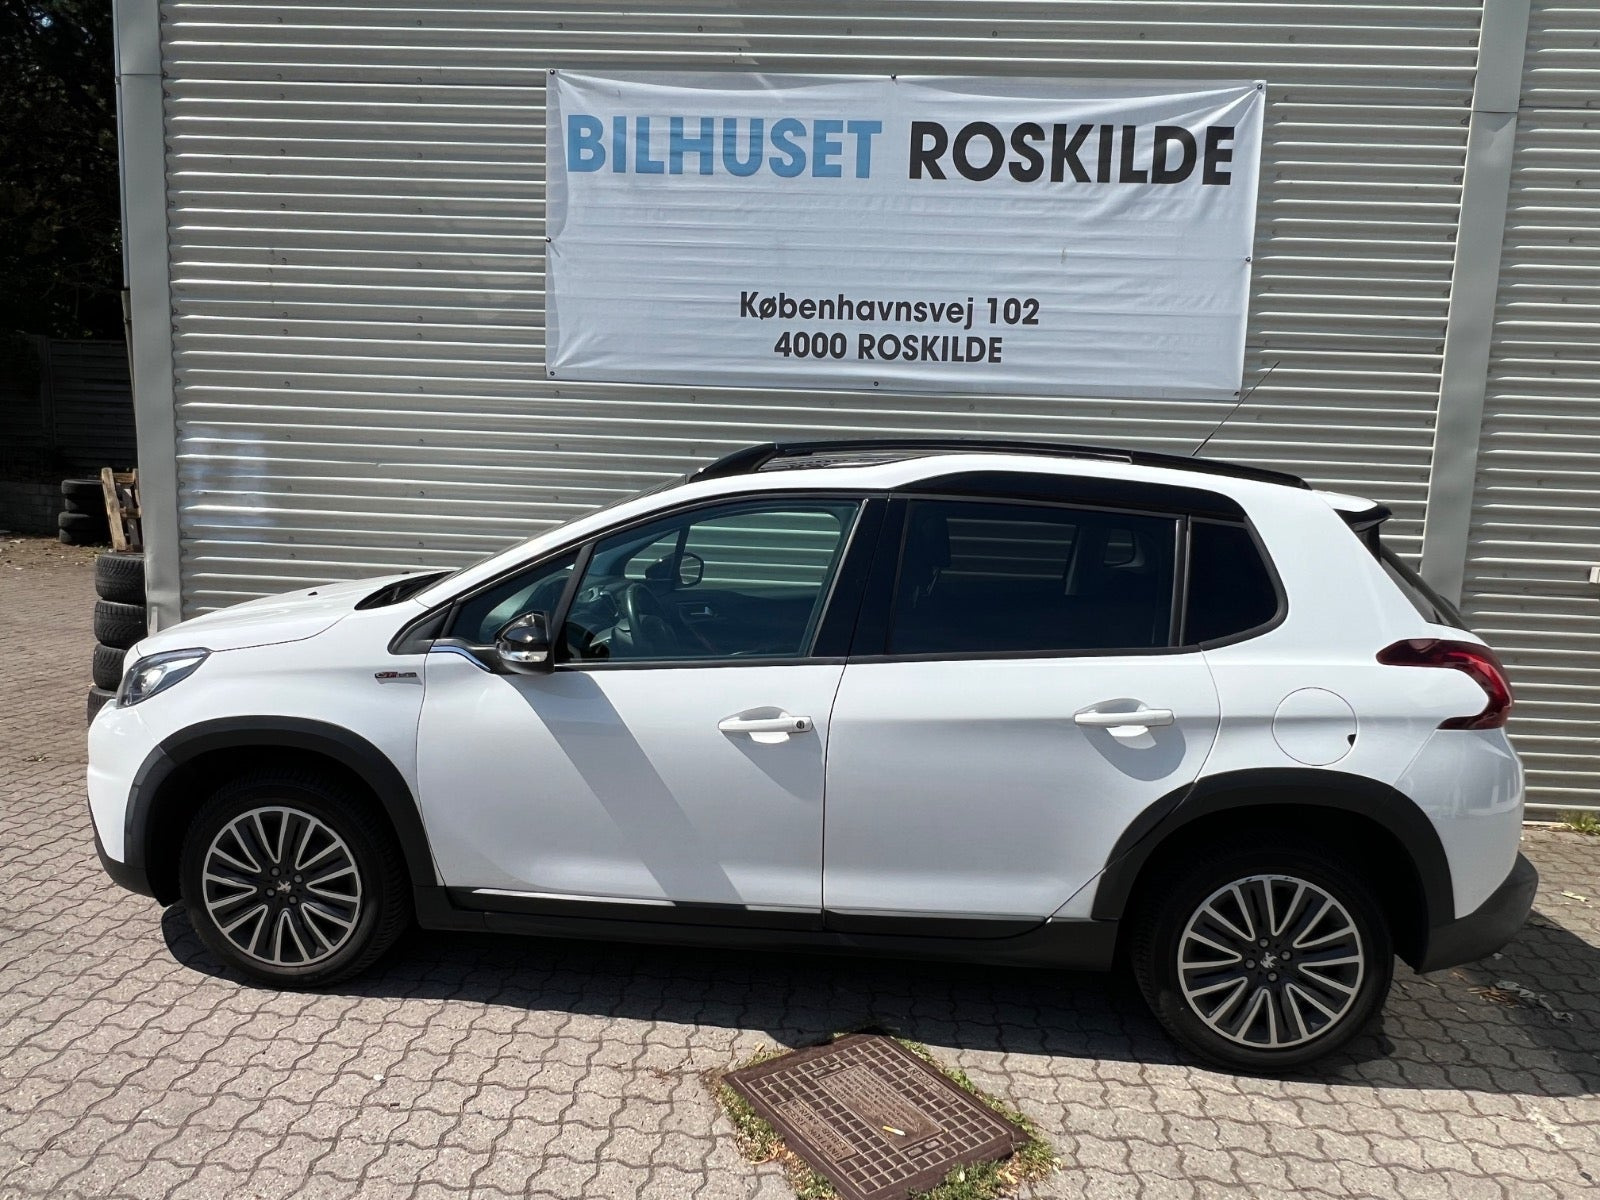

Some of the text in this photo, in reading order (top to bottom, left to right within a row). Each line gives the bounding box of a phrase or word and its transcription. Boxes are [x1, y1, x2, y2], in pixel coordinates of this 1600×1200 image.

[566, 112, 1235, 186] BILHUSET ROSKILDE
[740, 291, 1040, 330] Københavnsvej 102
[774, 331, 1003, 364] 4000 ROSKILDE
